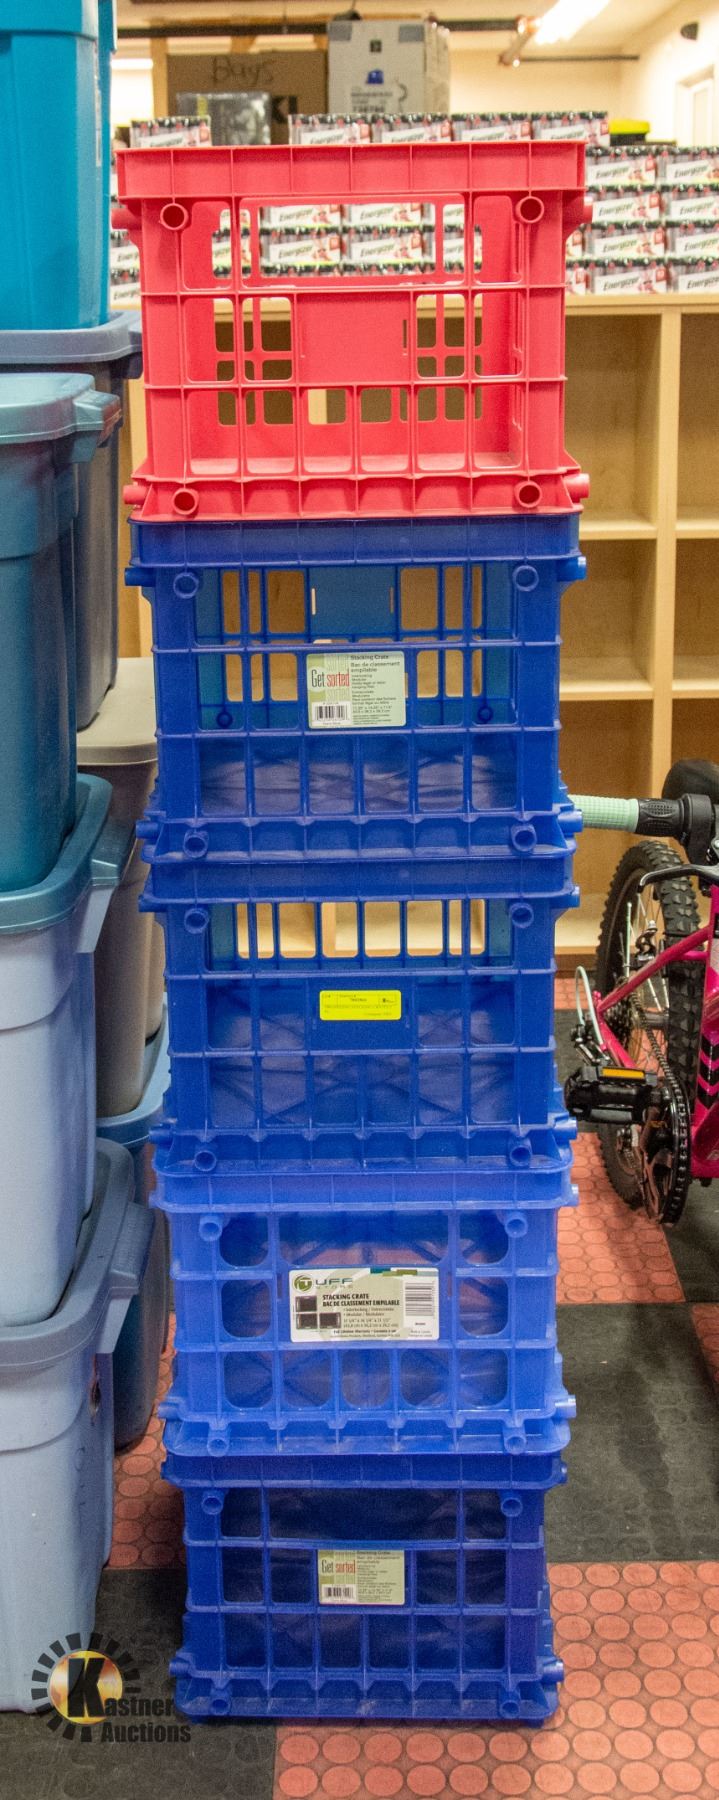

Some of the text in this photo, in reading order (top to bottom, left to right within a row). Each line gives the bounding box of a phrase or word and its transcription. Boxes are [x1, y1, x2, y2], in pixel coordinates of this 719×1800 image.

[603, 276, 639, 291] Energizer
[312, 669, 325, 687] Get
[327, 668, 350, 687] sorted
[321, 1559, 334, 1574] Get
[336, 1559, 355, 1574] sorted
